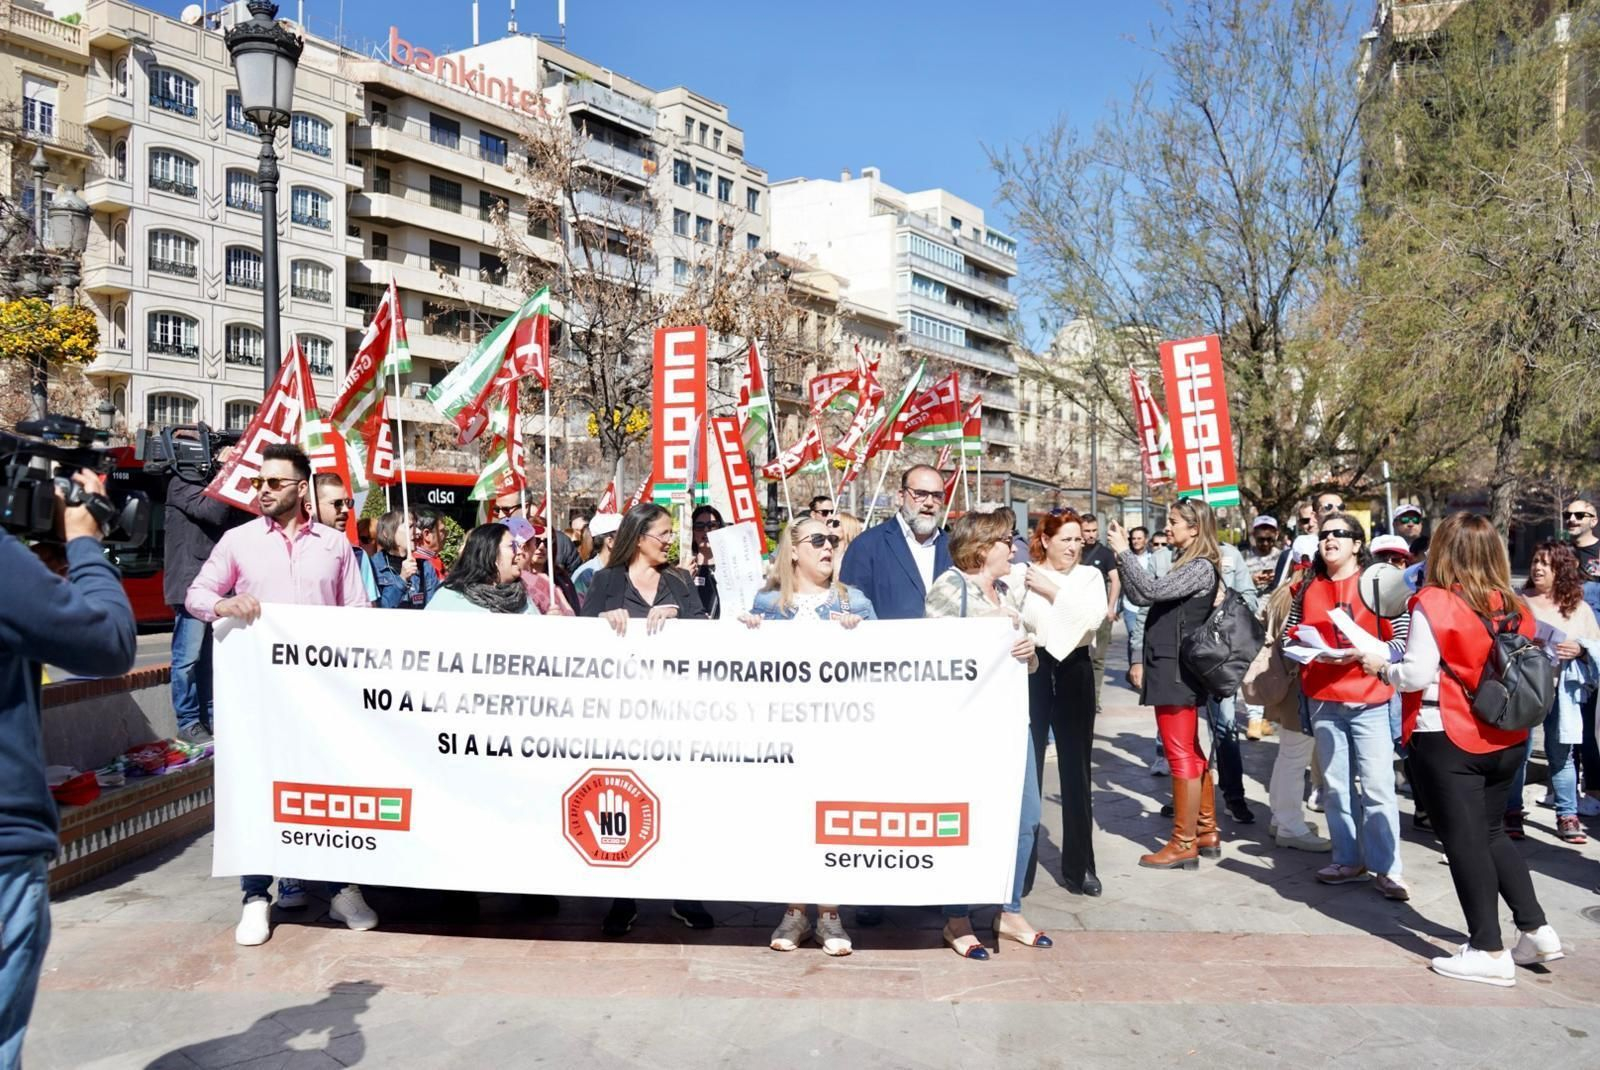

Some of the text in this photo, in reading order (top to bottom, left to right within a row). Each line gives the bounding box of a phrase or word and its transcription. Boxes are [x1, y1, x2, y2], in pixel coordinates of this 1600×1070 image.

[389, 25, 551, 120] bankinter
[663, 331, 697, 479] CCOO
[1173, 340, 1225, 486] CCOO
[427, 488, 455, 504] alsa
[271, 643, 978, 683] EN CONTRA DE LA LIBERALIZACIÓN DE HORARIOS COMERCIALES
[363, 688, 876, 723] NO A LA APERTURA EN DOMINGOS Y FESTIVOS
[437, 732, 457, 755] SI
[464, 734, 479, 756] A
[486, 735, 513, 757] LA
[690, 740, 794, 764] FAMILIAR
[280, 790, 376, 821] CCOO
[600, 811, 627, 836] NO
[824, 810, 934, 838] CCOO
[281, 829, 377, 851] servicios
[824, 849, 934, 869] servicios
